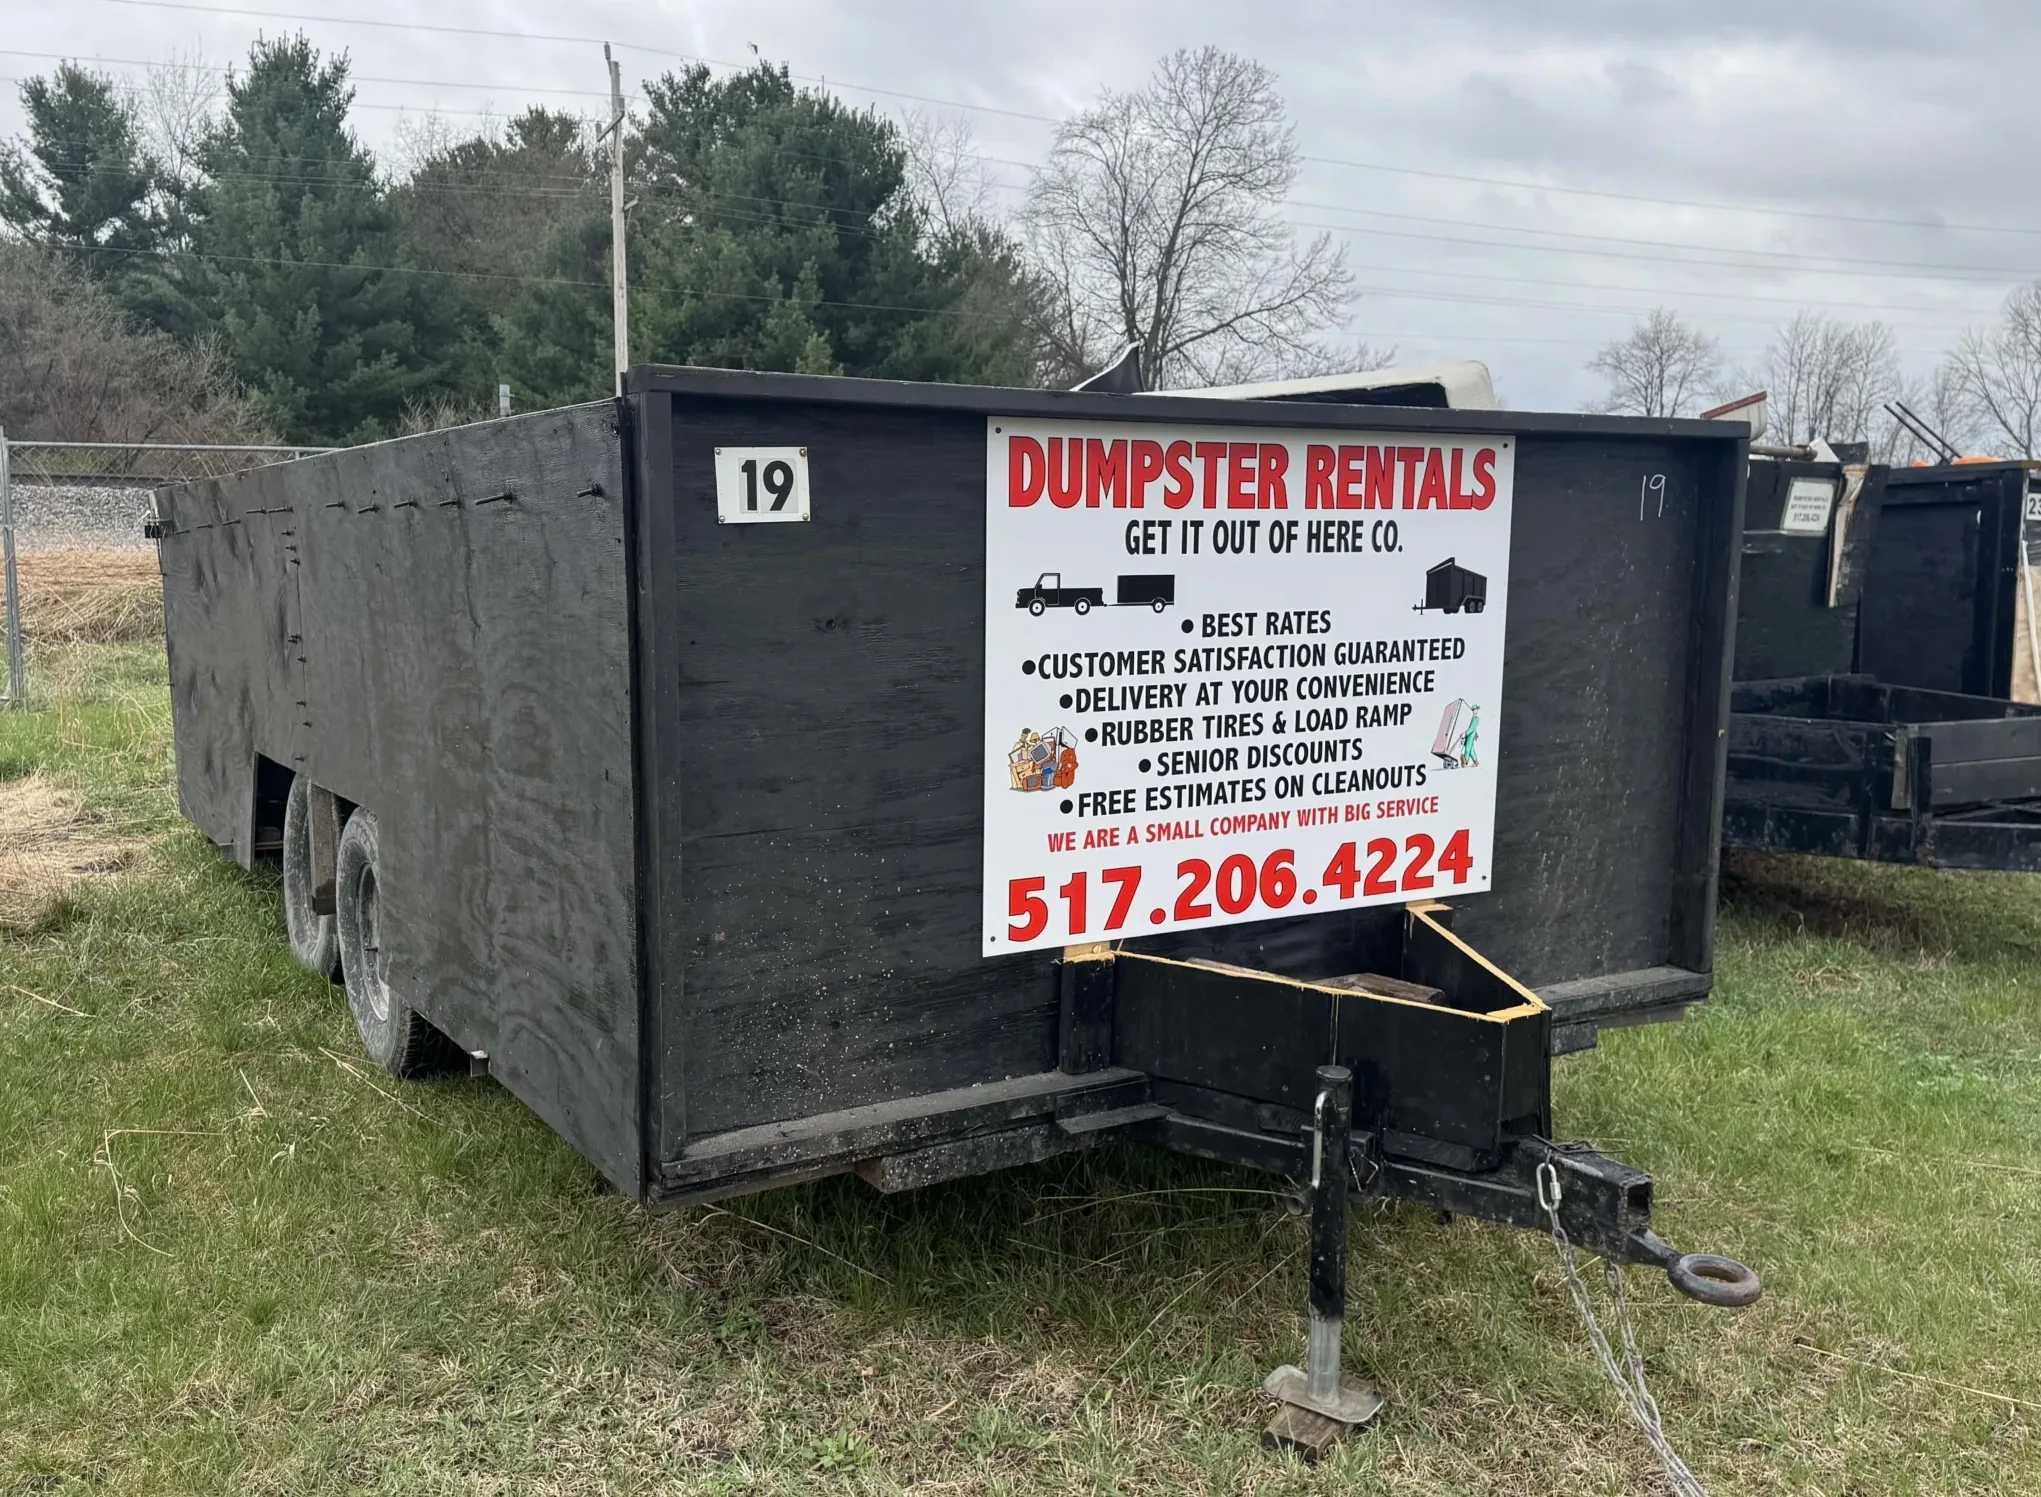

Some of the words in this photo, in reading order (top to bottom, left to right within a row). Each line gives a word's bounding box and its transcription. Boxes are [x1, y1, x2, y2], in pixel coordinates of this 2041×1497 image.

[740, 459, 795, 512] 19
[1008, 436, 1290, 510] DUMPSTER
[1304, 444, 1497, 511] RENTALS
[1640, 473, 1667, 521] 19
[1125, 519, 1173, 555] GET
[1181, 519, 1204, 555] IT
[1212, 519, 1261, 554] OUT
[1268, 519, 1299, 554] OF
[1306, 519, 1364, 553] HERE
[1371, 519, 1403, 553] CO.
[1201, 612, 1258, 638] BEST
[1265, 610, 1332, 636] RATES
[1038, 649, 1166, 679] CUSTOMER
[1173, 643, 1326, 673] SATISFACTION
[1334, 637, 1466, 666] GUARANTEED
[1075, 683, 1188, 713] DELIVERY
[1195, 681, 1223, 706] AT
[1231, 678, 1289, 704] YOUR
[1296, 669, 1435, 700] CONVENIENCE
[1101, 716, 1194, 747] RUBBER
[1202, 712, 1264, 740] TIRES
[1272, 710, 1287, 735] &
[1295, 707, 1349, 733] LOAD
[1355, 703, 1412, 729] RAMP
[1156, 747, 1239, 777] SENIOR
[1247, 737, 1363, 770] DISCOUNTS
[1078, 788, 1137, 818] FREE
[1145, 777, 1267, 811] ESTIMATES
[1274, 773, 1304, 800] ON
[1311, 763, 1427, 796] CLEANOUTS
[1047, 831, 1077, 853] WE
[1083, 827, 1120, 850] ARE
[1126, 825, 1139, 846] A
[1145, 819, 1204, 843] SMALL
[1210, 810, 1291, 836] COMPANY
[1296, 805, 1339, 827] WITH
[1344, 803, 1371, 822] BIG
[1376, 796, 1440, 820] SERVICE
[1008, 828, 1474, 943] 517.206.4224
